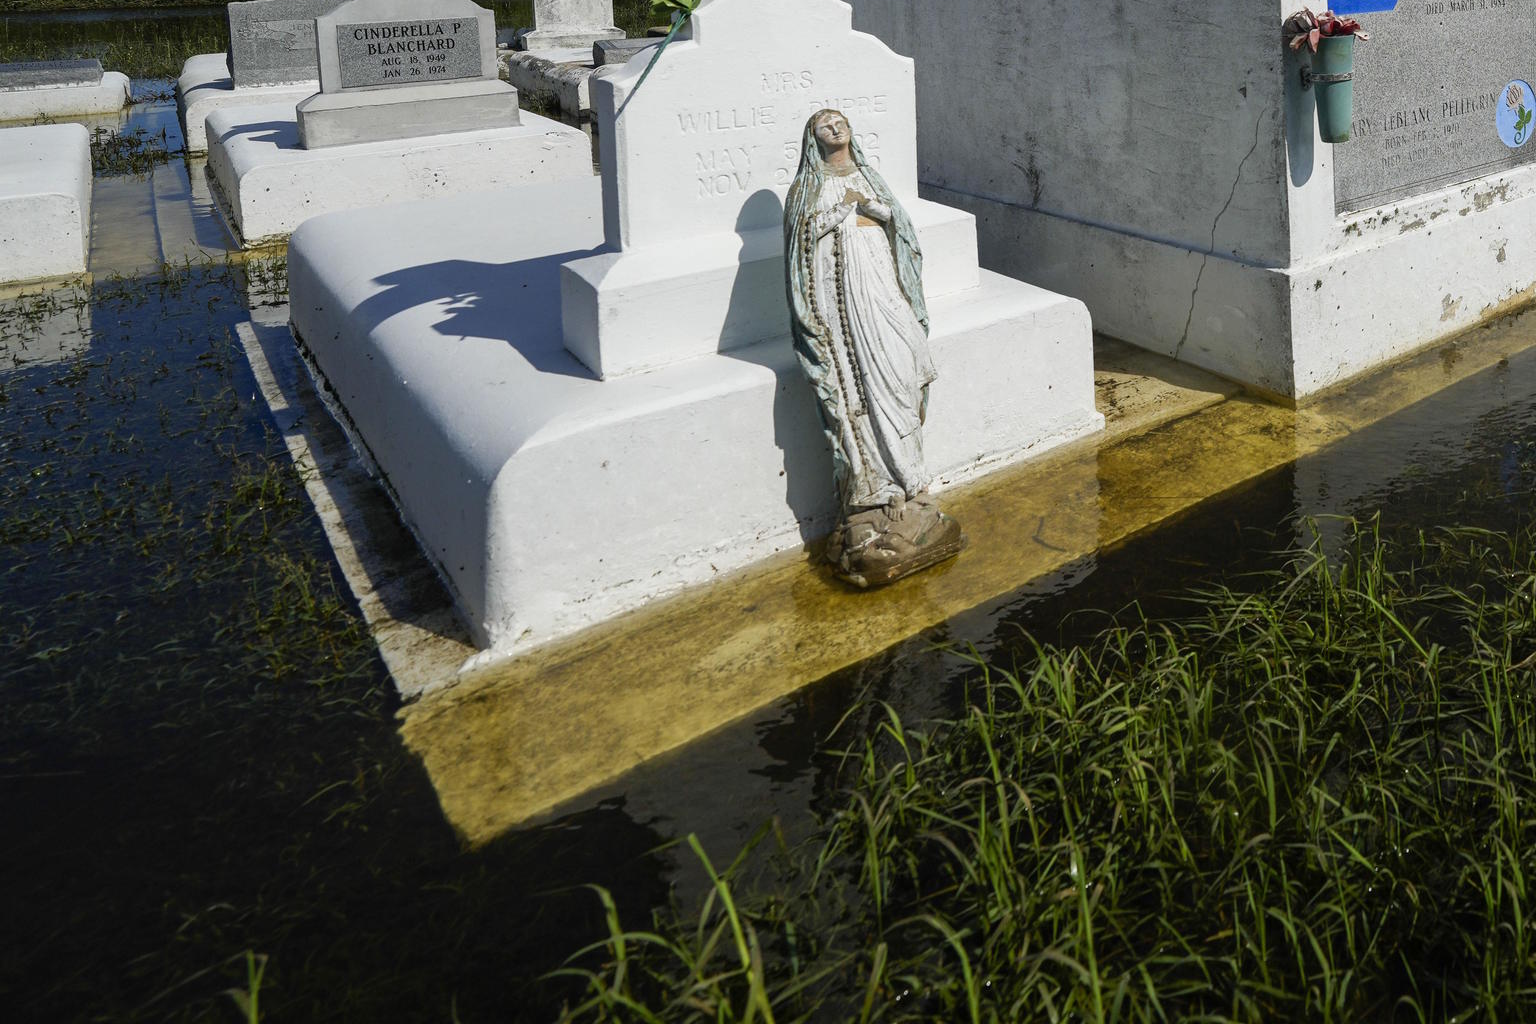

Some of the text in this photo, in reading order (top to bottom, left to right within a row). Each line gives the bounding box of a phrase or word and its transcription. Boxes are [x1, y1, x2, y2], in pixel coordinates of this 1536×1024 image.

[1426, 2, 1444, 16] DIED
[1450, 0, 1475, 12] MARCH
[353, 22, 461, 41] CINDERELLA P
[367, 38, 455, 56] BLANCHARD
[381, 58, 401, 67] AUG
[426, 53, 446, 63] 1949
[382, 69, 401, 79] JAN
[428, 65, 446, 75] 1974
[759, 70, 814, 93] MRS
[1442, 92, 1498, 118] PELLEGRIN
[676, 105, 775, 135] WILLIE
[695, 145, 760, 172] MAY
[697, 171, 751, 199] NOV
